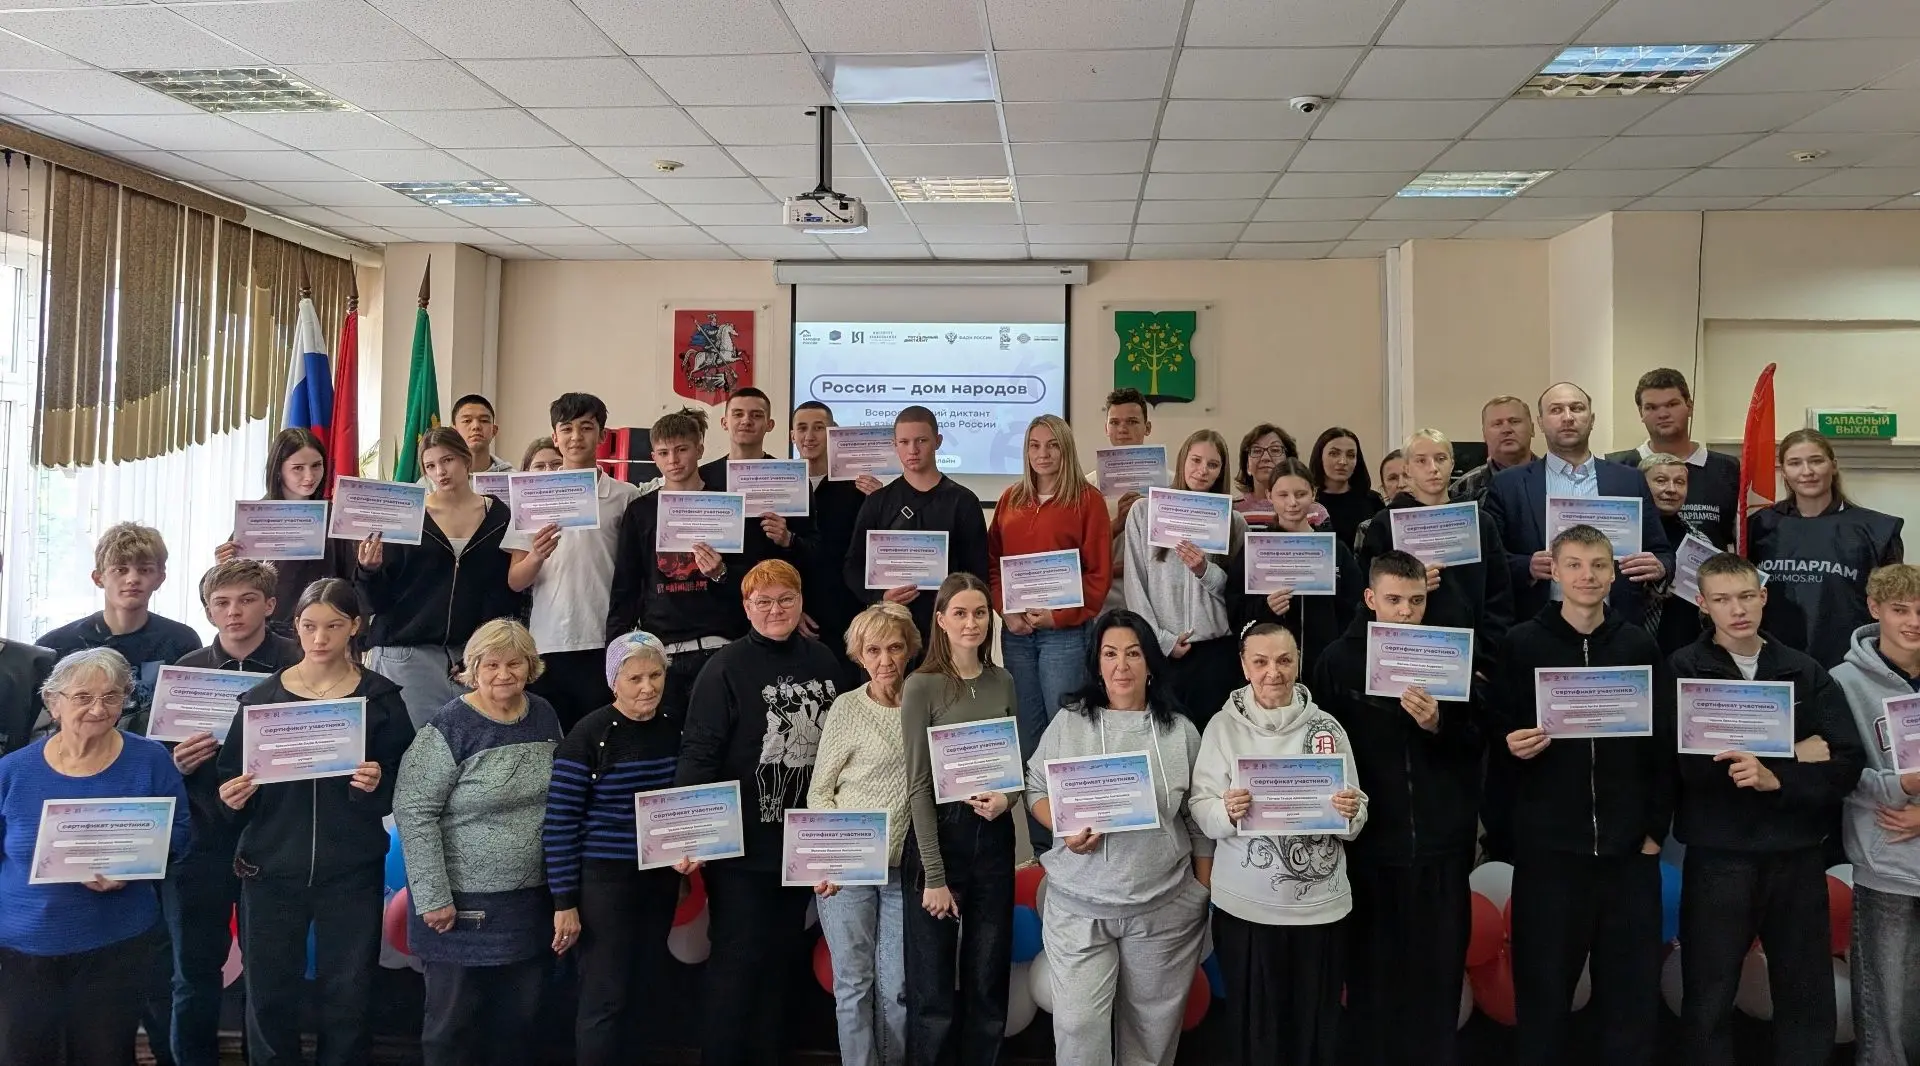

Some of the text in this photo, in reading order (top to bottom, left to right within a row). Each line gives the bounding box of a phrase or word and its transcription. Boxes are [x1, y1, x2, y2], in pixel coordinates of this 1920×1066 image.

[822, 381, 886, 394] Россия
[910, 384, 946, 395] дом
[952, 384, 1028, 396] народов
[950, 410, 990, 418] диктант
[959, 420, 996, 428] России
[1825, 415, 1890, 425] ЗАПАСНЫЙ
[1836, 425, 1879, 436] ВЫХОД
[1680, 503, 1720, 513] ОЛОДЕЖНЫЙ
[1254, 778, 1329, 786] сертификат участника
